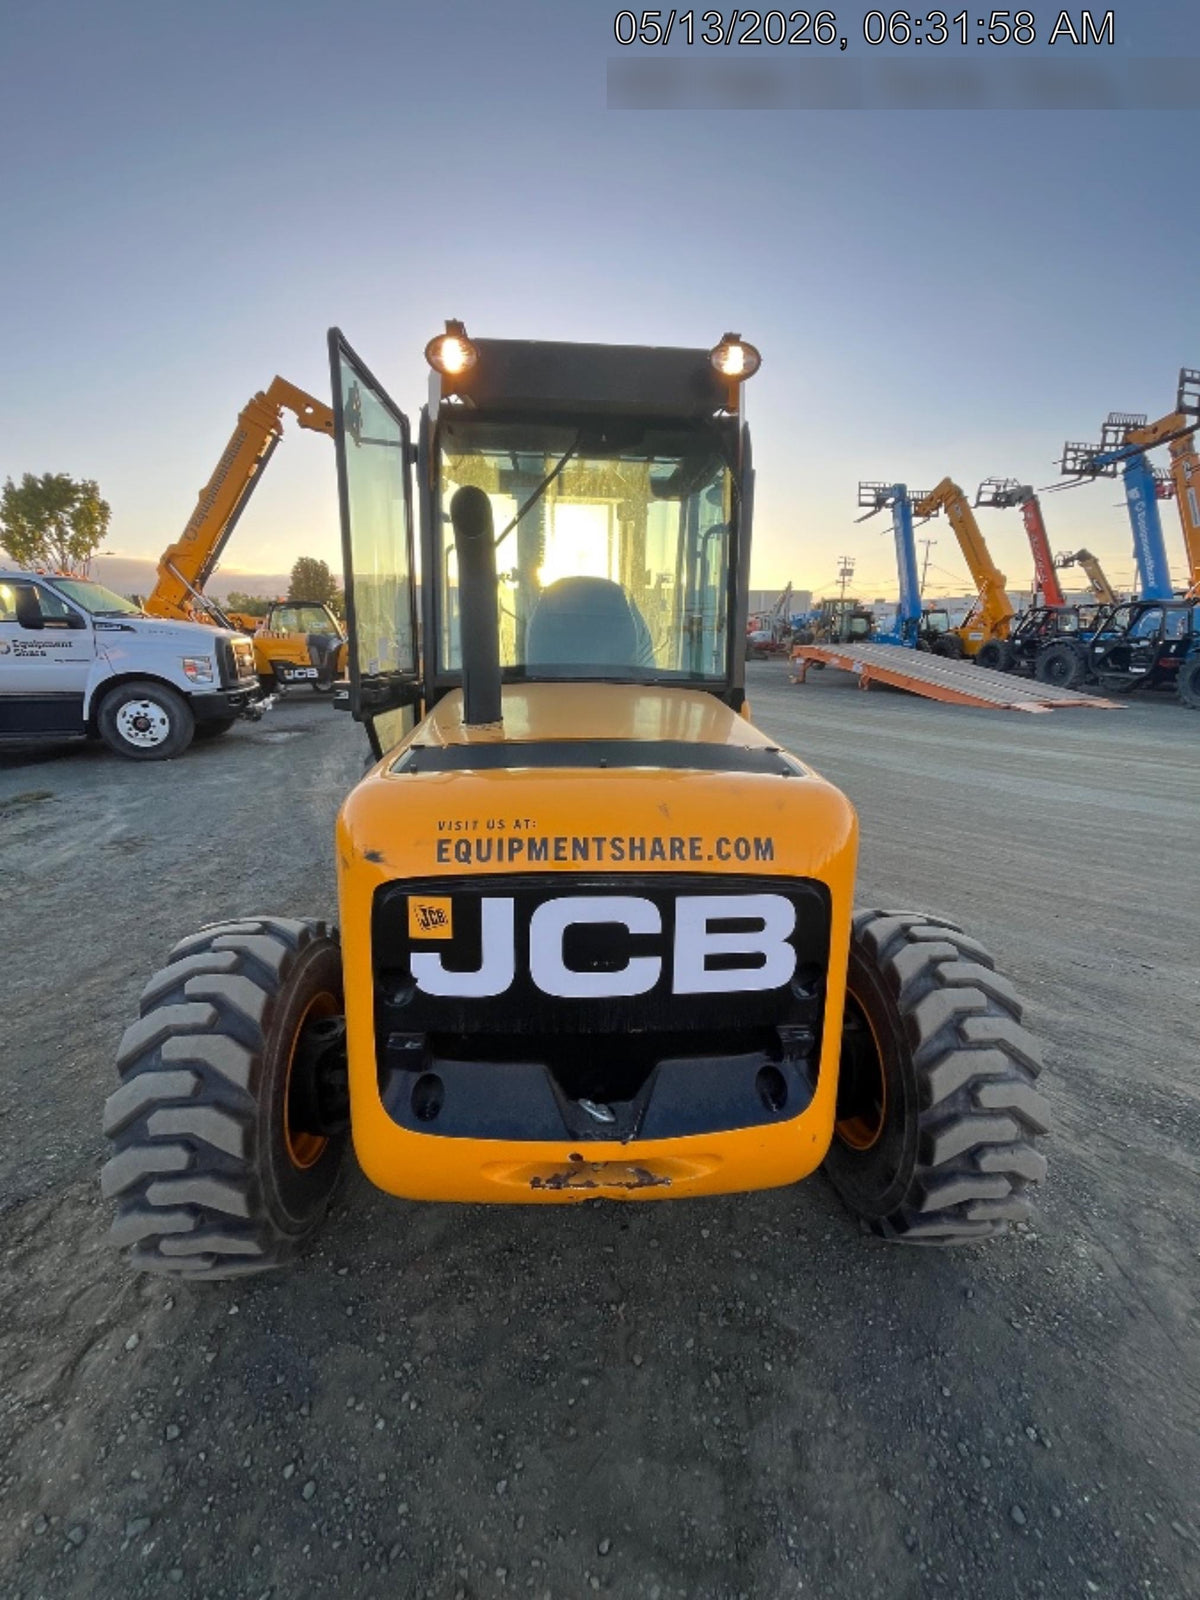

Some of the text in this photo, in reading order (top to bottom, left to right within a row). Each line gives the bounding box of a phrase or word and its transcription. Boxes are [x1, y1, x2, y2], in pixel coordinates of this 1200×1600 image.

[283, 668, 319, 680] JCB
[438, 819, 537, 831] VISIT US AT:
[436, 836, 775, 864] EQUIPMENTSHARE.COM
[420, 907, 446, 927] JCB
[409, 894, 798, 998] JCB
